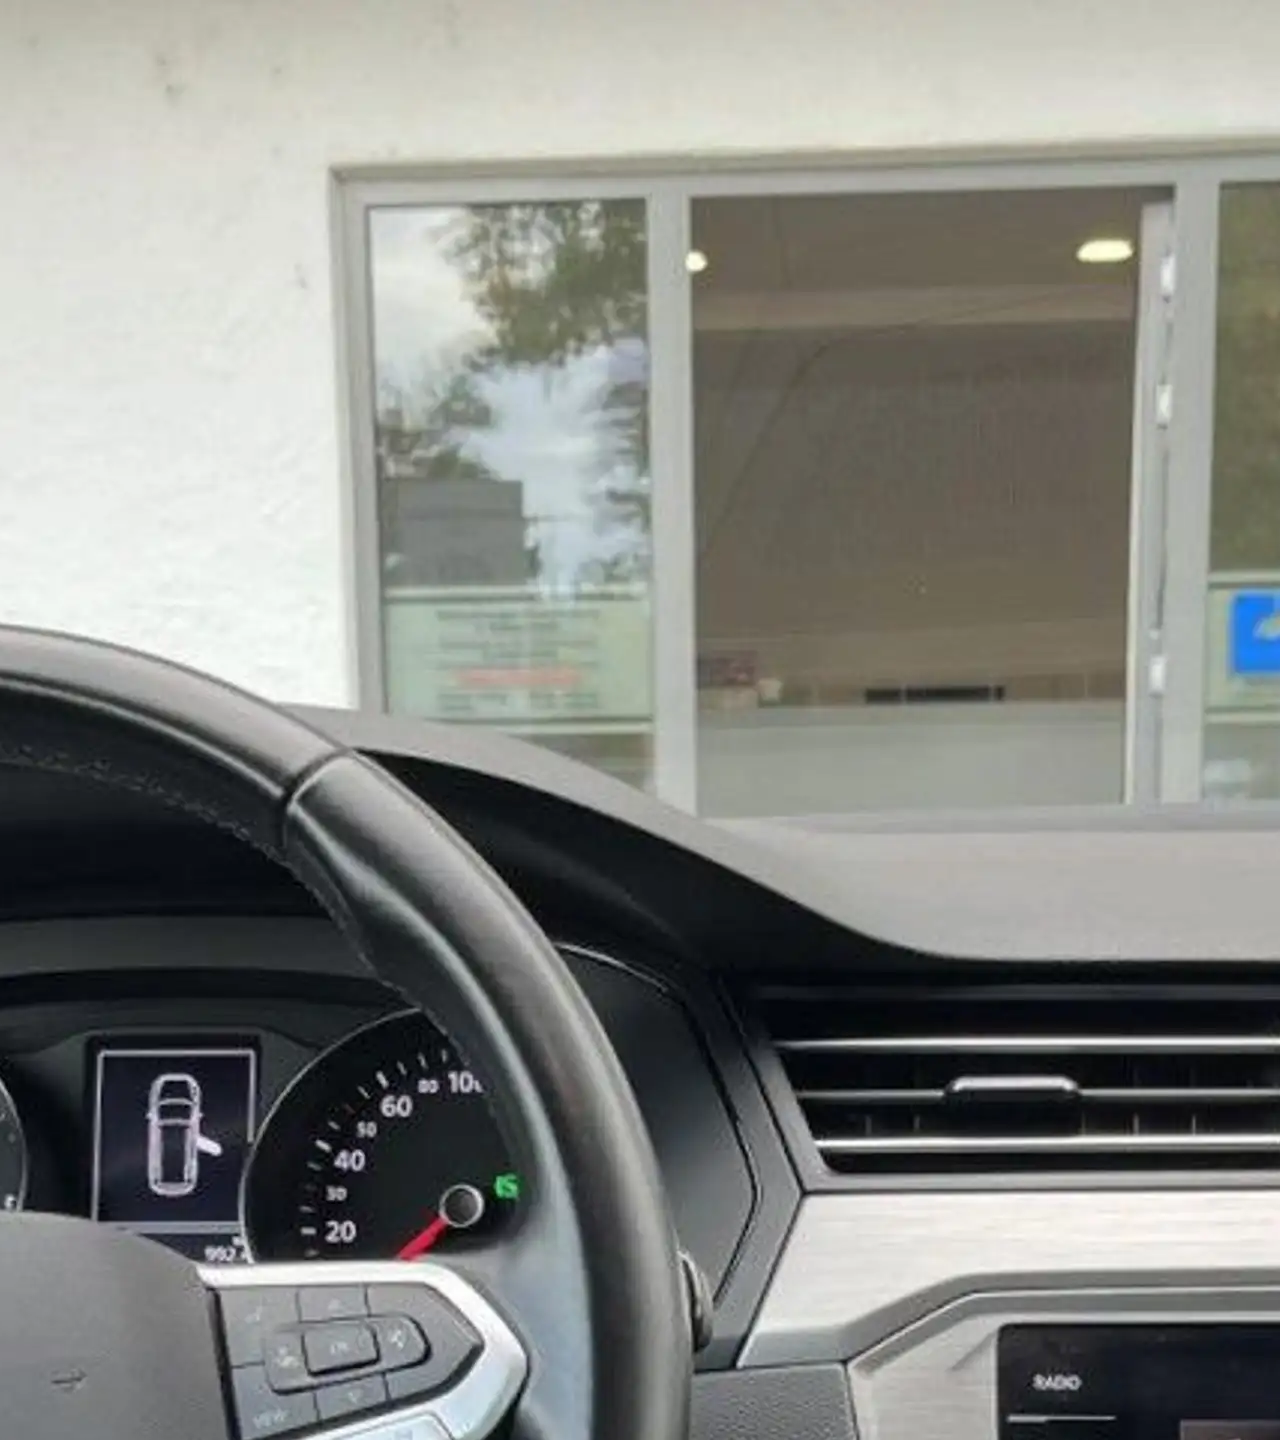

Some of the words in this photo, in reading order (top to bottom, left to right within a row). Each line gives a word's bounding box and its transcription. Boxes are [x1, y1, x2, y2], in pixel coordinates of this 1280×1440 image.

[380, 1095, 414, 1119] 60
[333, 1149, 366, 1173] 40
[325, 1219, 357, 1243] 20
[1032, 1374, 1082, 1391] RADIO
